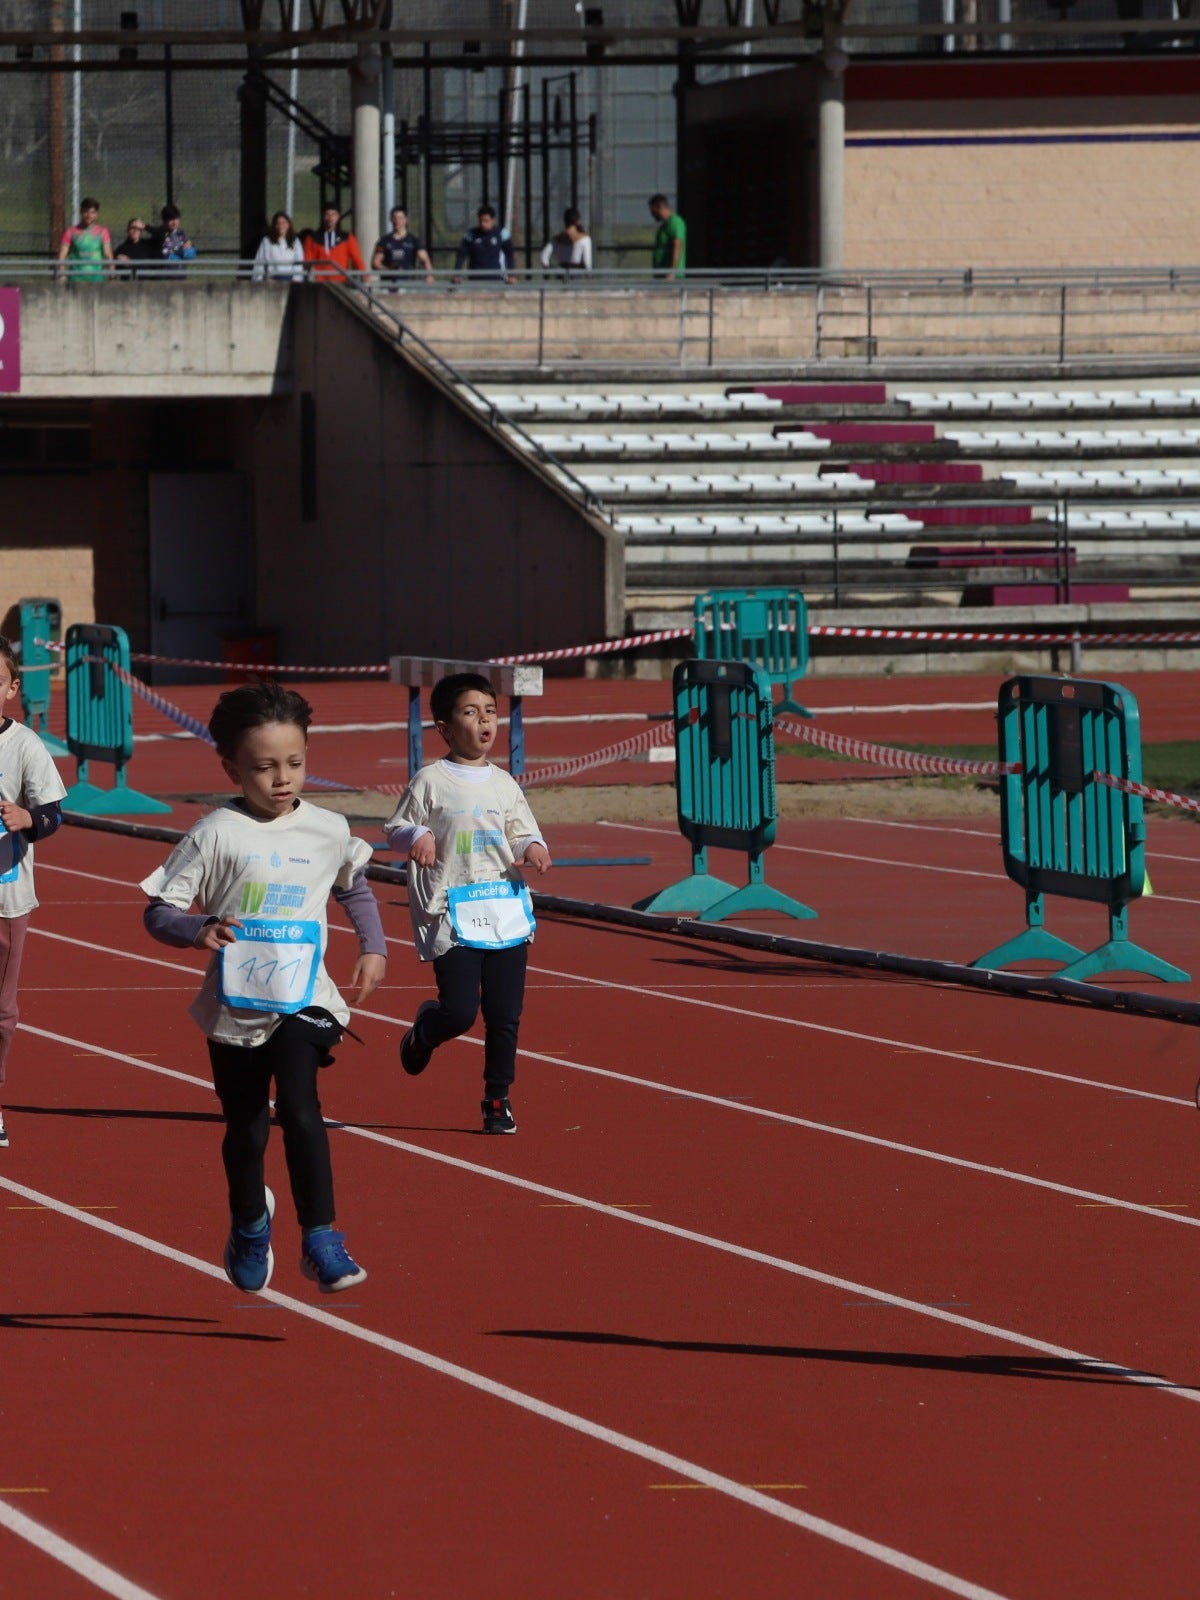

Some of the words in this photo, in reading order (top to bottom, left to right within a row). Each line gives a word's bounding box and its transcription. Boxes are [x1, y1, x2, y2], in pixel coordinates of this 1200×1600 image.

[468, 885, 499, 898] unicef
[472, 917, 491, 928] 122
[244, 925, 287, 939] unicef
[237, 957, 302, 989] 111
